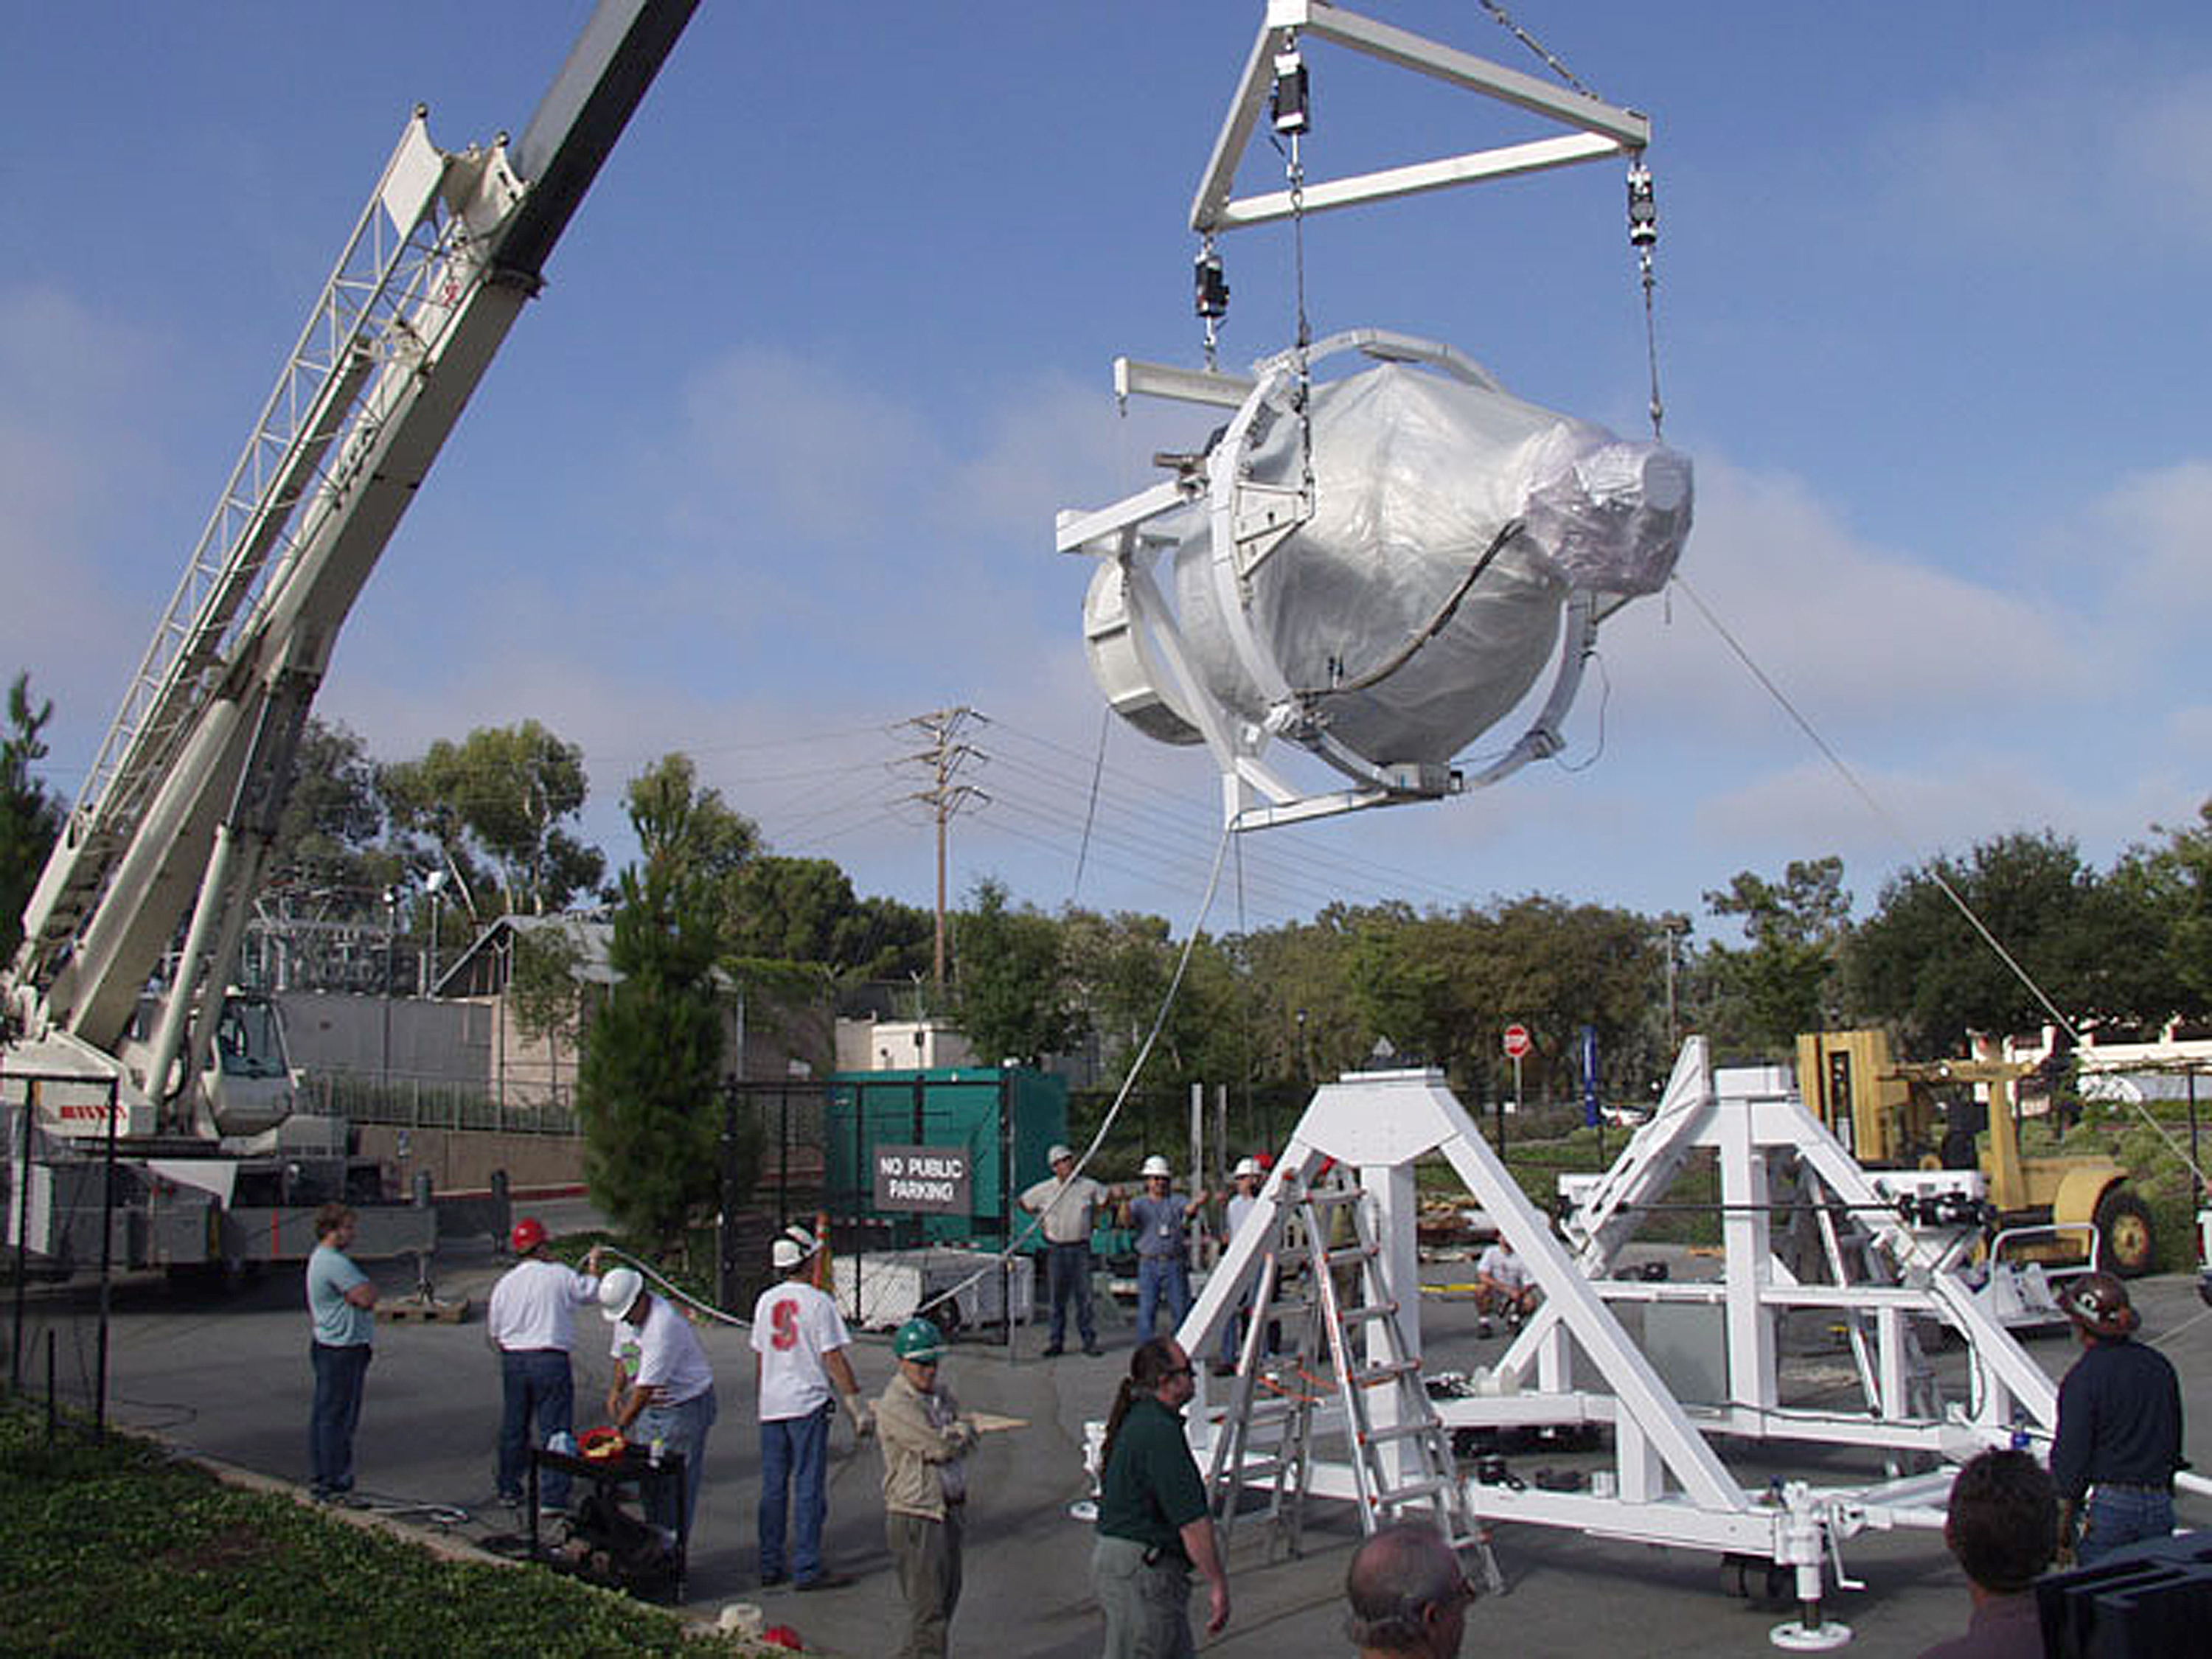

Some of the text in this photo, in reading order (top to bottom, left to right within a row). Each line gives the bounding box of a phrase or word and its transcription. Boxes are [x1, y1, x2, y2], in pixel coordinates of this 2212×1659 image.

[881, 1157, 962, 1178] NO PUBLIC
[889, 1179, 953, 1201] PARKING
[771, 1300, 799, 1352] S
